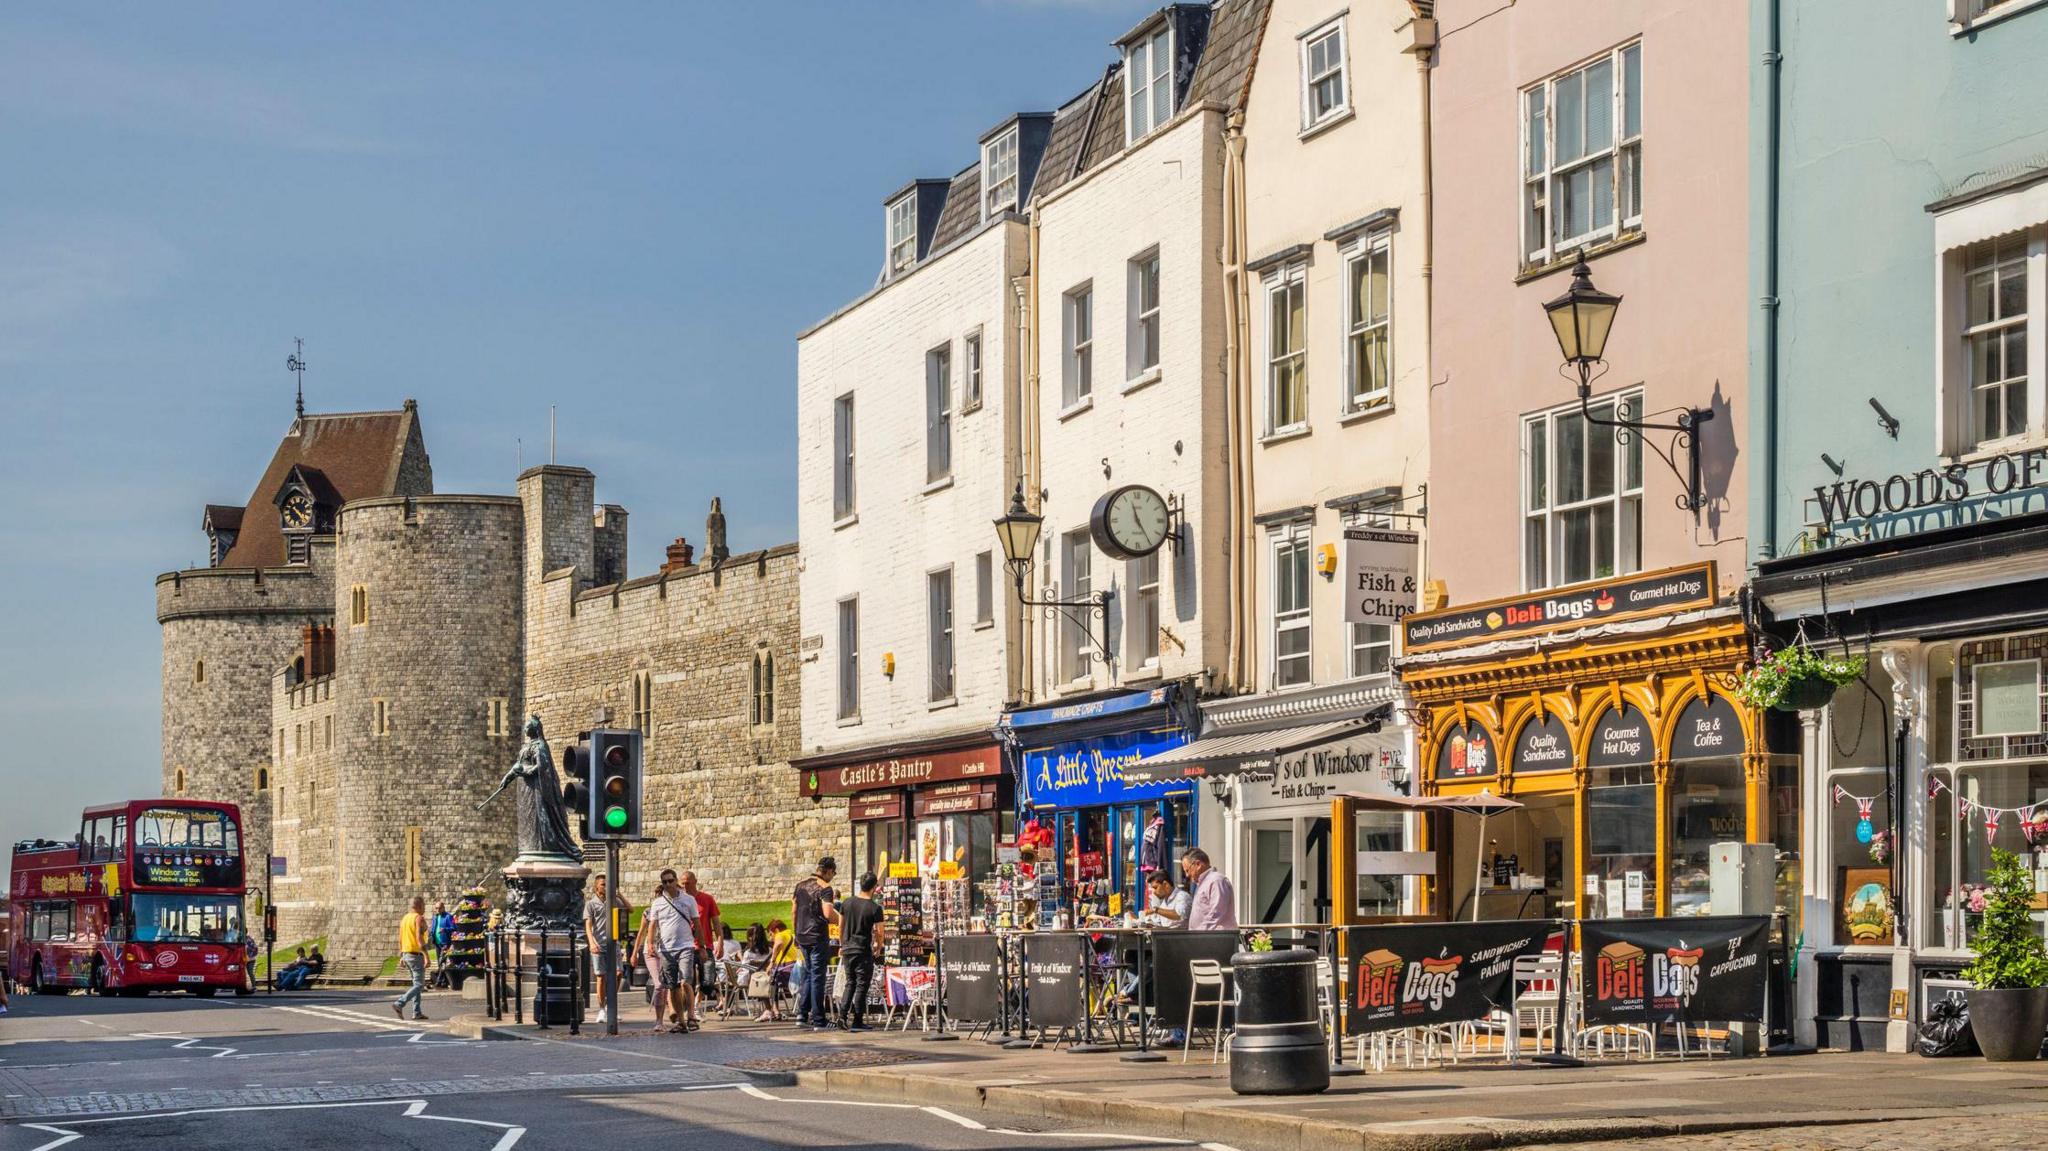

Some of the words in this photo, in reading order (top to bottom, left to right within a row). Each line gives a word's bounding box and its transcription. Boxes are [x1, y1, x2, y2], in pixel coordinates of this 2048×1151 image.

[1814, 462, 1969, 525] WOODS
[1388, 534, 1415, 542] Windsor
[1358, 572, 1396, 592] Fish
[1402, 576, 1416, 593] &
[1629, 587, 1664, 602] Gourmet
[1664, 584, 1678, 597] Hot
[1679, 581, 1701, 594] Dogs
[1361, 598, 1415, 622] Chips
[1506, 605, 1543, 625] Deli
[1545, 598, 1594, 620] Dogs
[1410, 626, 1433, 640] Quality
[1433, 624, 1445, 636] Deli
[1445, 617, 1482, 633] Sandwiches
[1604, 726, 1640, 740] Gourmet
[1695, 719, 1711, 732] Tea
[1712, 717, 1721, 731] &
[1529, 734, 1557, 750] Quality
[1602, 742, 1618, 755] Hot
[1619, 741, 1641, 756] Dogs
[1693, 732, 1723, 747] Coffee
[1293, 752, 1308, 779] of
[1312, 746, 1374, 777] Windsor
[1467, 742, 1487, 774] Dogs
[1523, 747, 1566, 762] Sandwiches
[840, 763, 885, 786] Castle's
[889, 759, 933, 784] Pantry
[1036, 756, 1052, 792] A
[1055, 750, 1089, 790] Little
[1281, 784, 1295, 799] Fish
[1297, 784, 1303, 797] &
[1304, 782, 1326, 800] Chips
[150, 868, 180, 876] Windsor
[184, 868, 199, 877] Tour
[1470, 937, 1531, 963] SANDWICHES
[1728, 936, 1741, 950] TEA
[1710, 953, 1757, 978] CAPPUCCINO
[1728, 952, 1735, 961] &
[1480, 959, 1511, 980] PANINI
[1358, 964, 1399, 1010] Deli
[1403, 962, 1459, 1011] Dogs
[1596, 957, 1645, 1000] Deli
[1652, 953, 1700, 1008] Dogs
